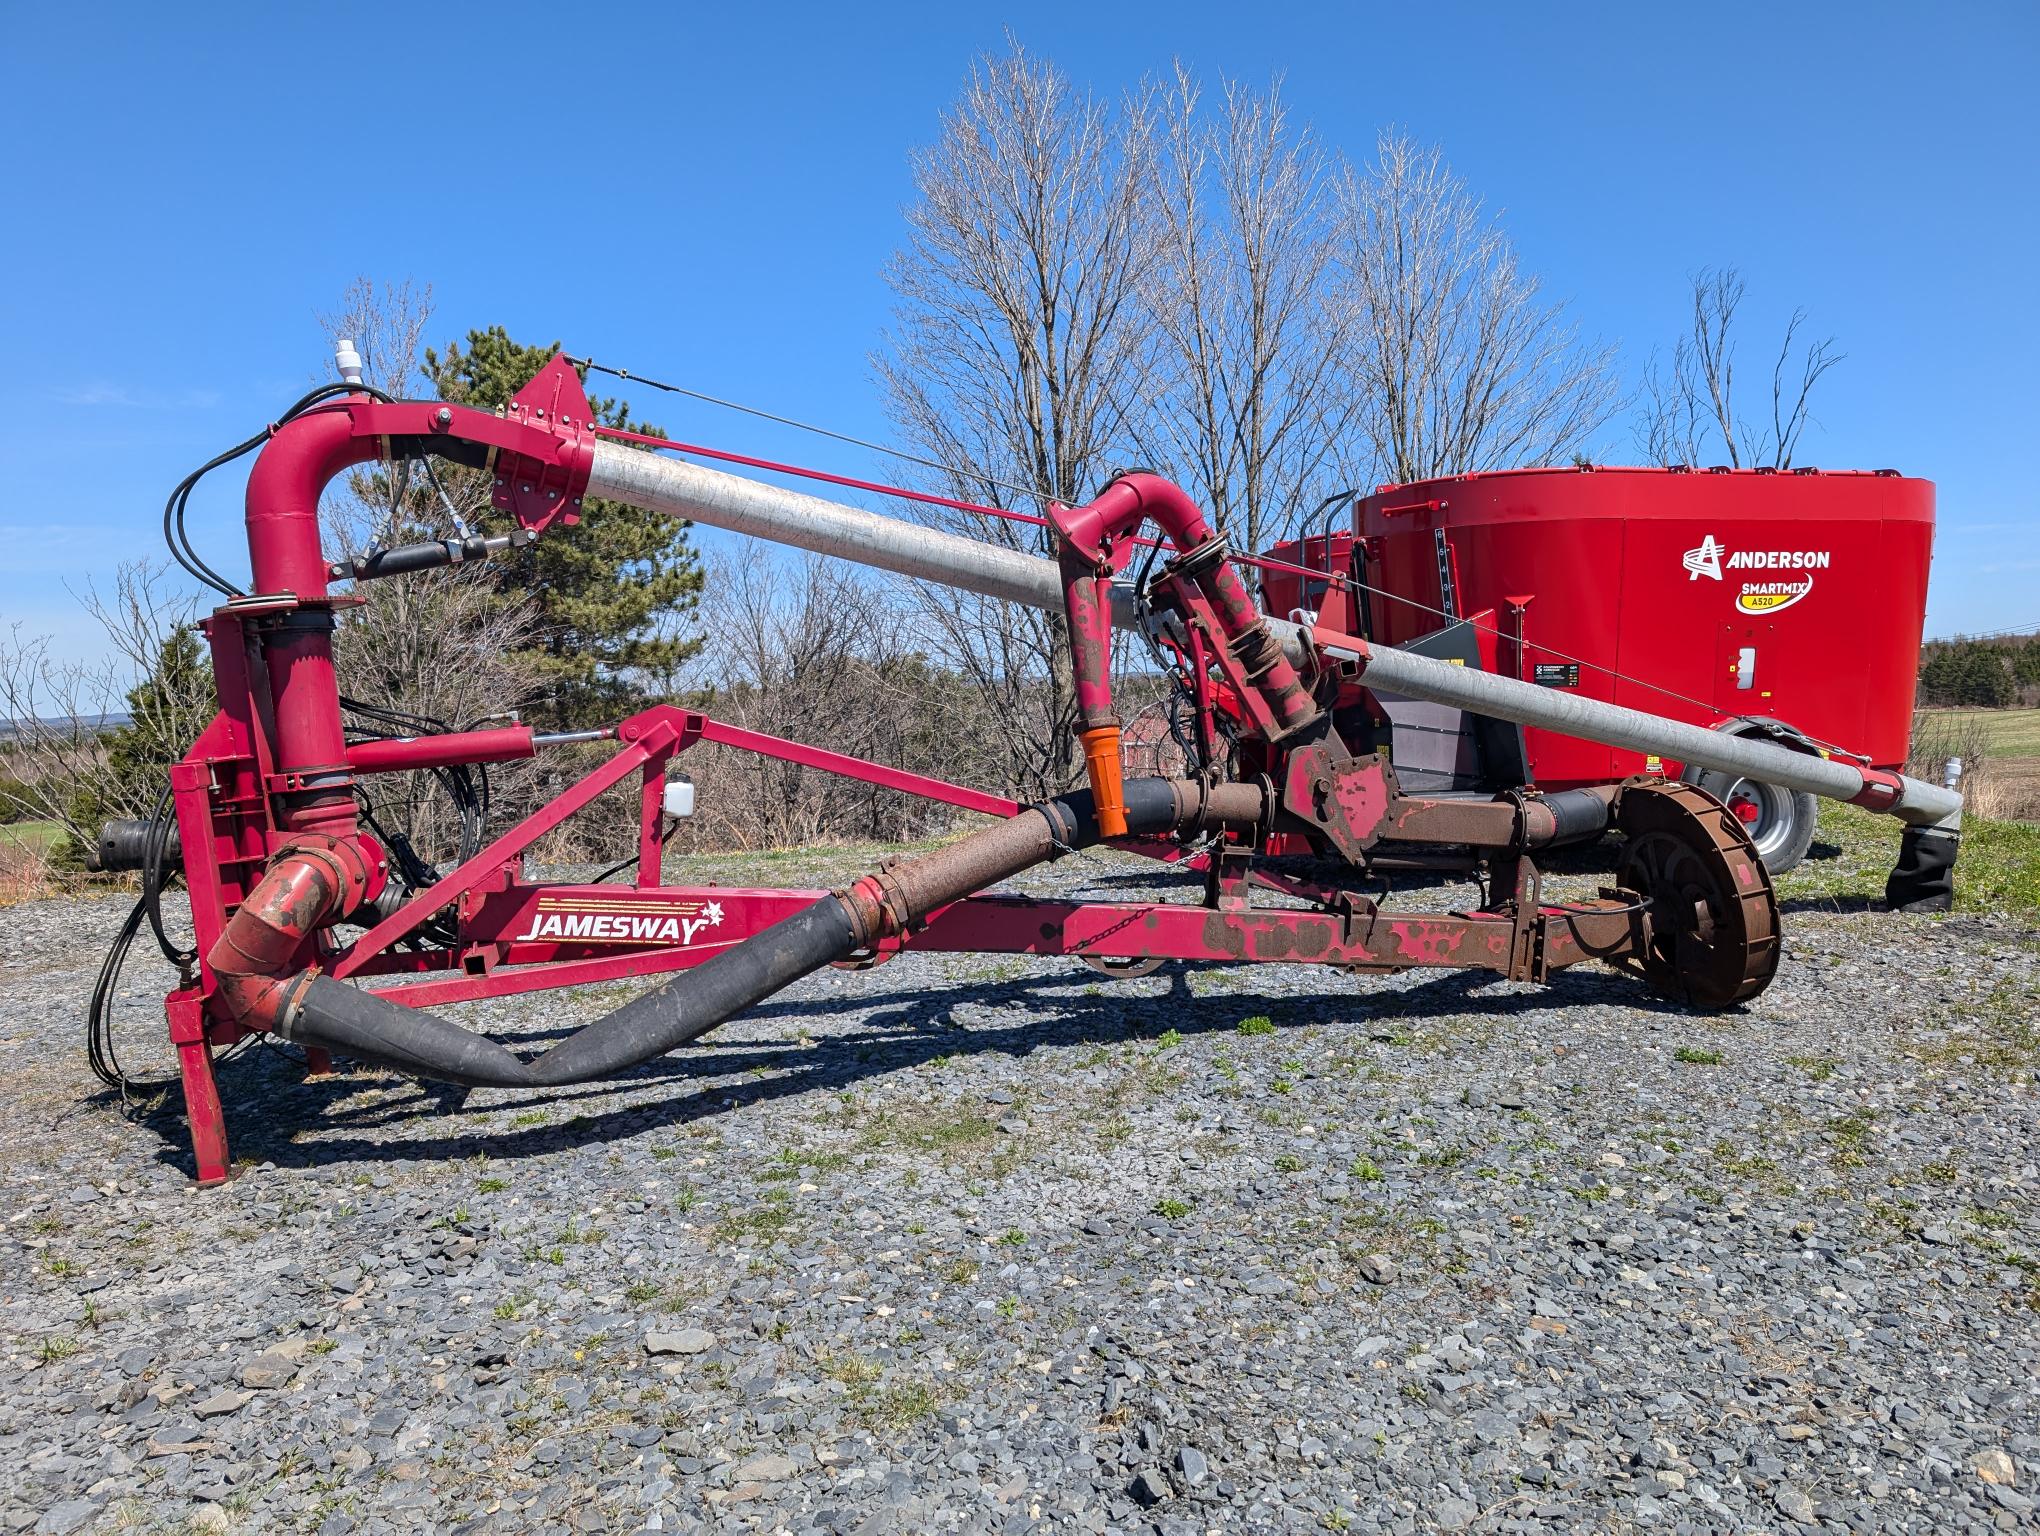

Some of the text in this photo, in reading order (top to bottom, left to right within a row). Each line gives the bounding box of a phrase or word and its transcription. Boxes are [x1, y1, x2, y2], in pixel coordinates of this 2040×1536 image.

[1725, 551, 1830, 569] ANDERSON
[1741, 582, 1806, 595] SMARTMIX
[1751, 597, 1774, 606] A520
[516, 914, 710, 946] JAMESWAY
